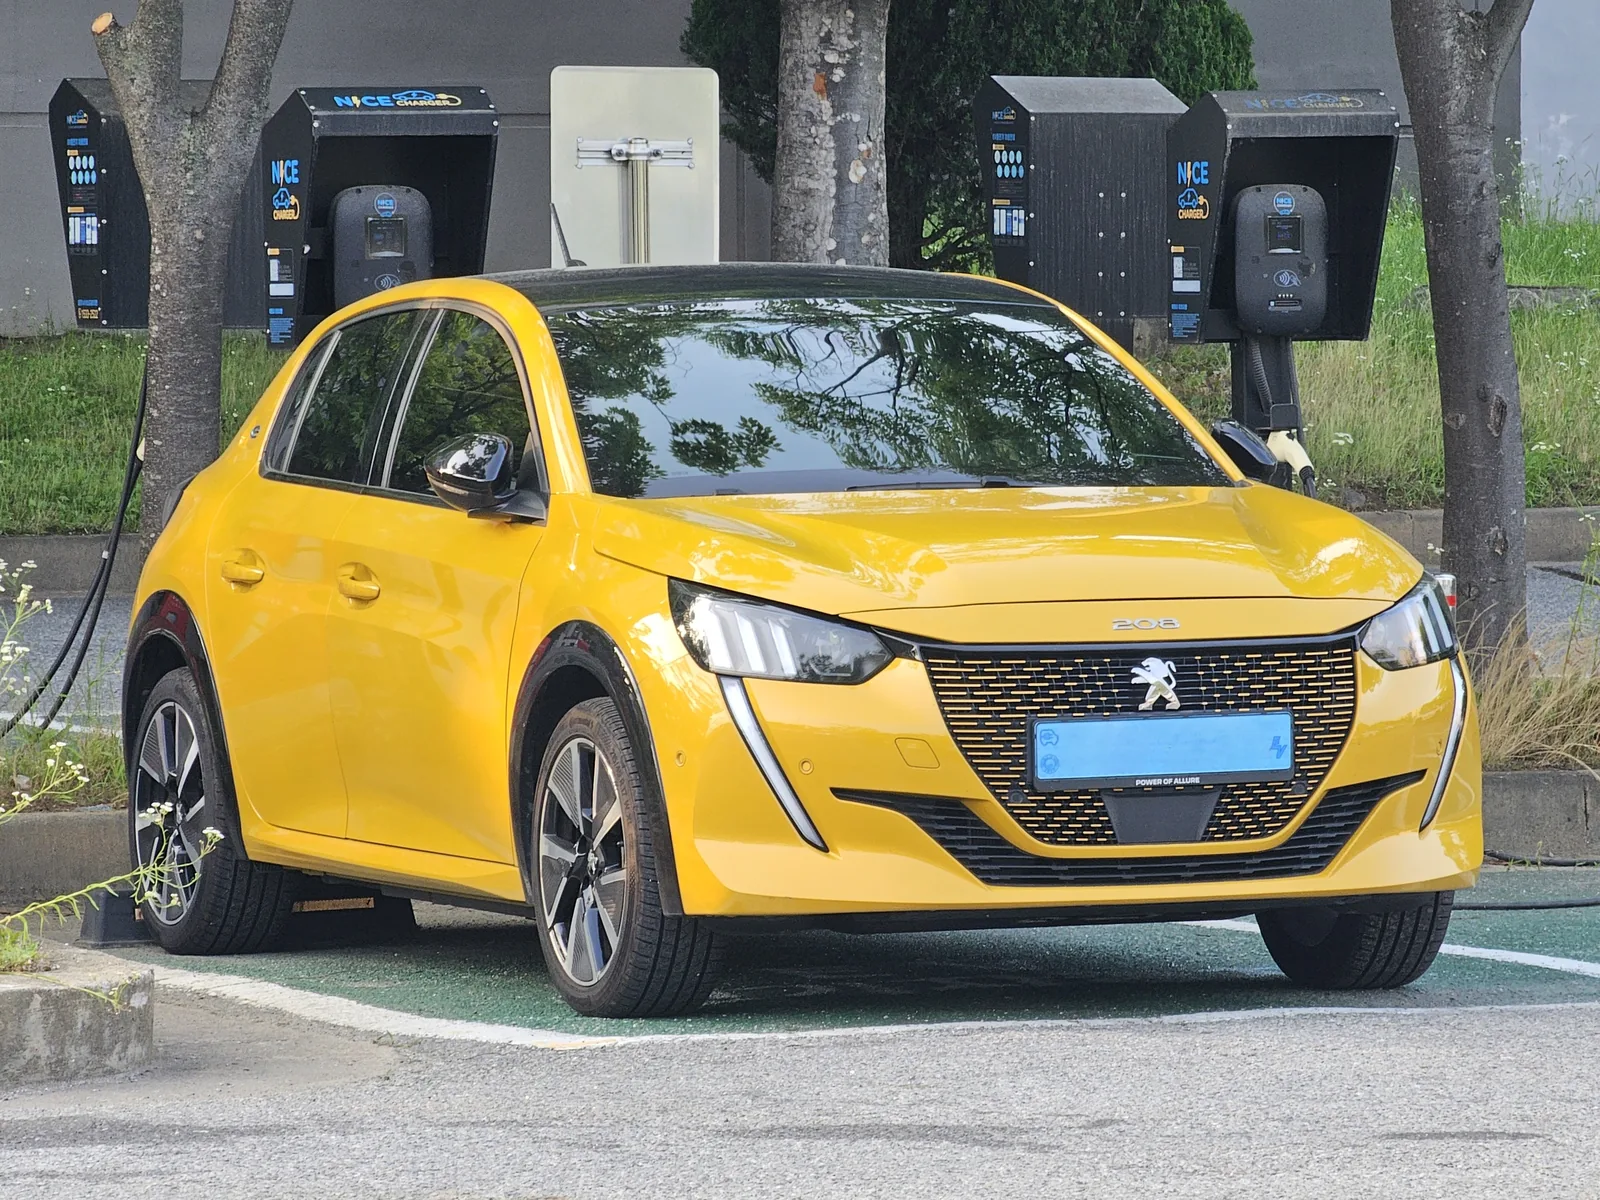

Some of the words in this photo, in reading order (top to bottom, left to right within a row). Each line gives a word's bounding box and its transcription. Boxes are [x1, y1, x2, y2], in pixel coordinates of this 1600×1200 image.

[333, 96, 395, 108] NICE
[271, 159, 300, 188] NICE
[1177, 161, 1209, 188] NICE
[1178, 209, 1204, 220] CHARGER
[1112, 618, 1180, 631] 208
[1135, 778, 1162, 786] POWER
[1173, 776, 1200, 784] ALLURE
